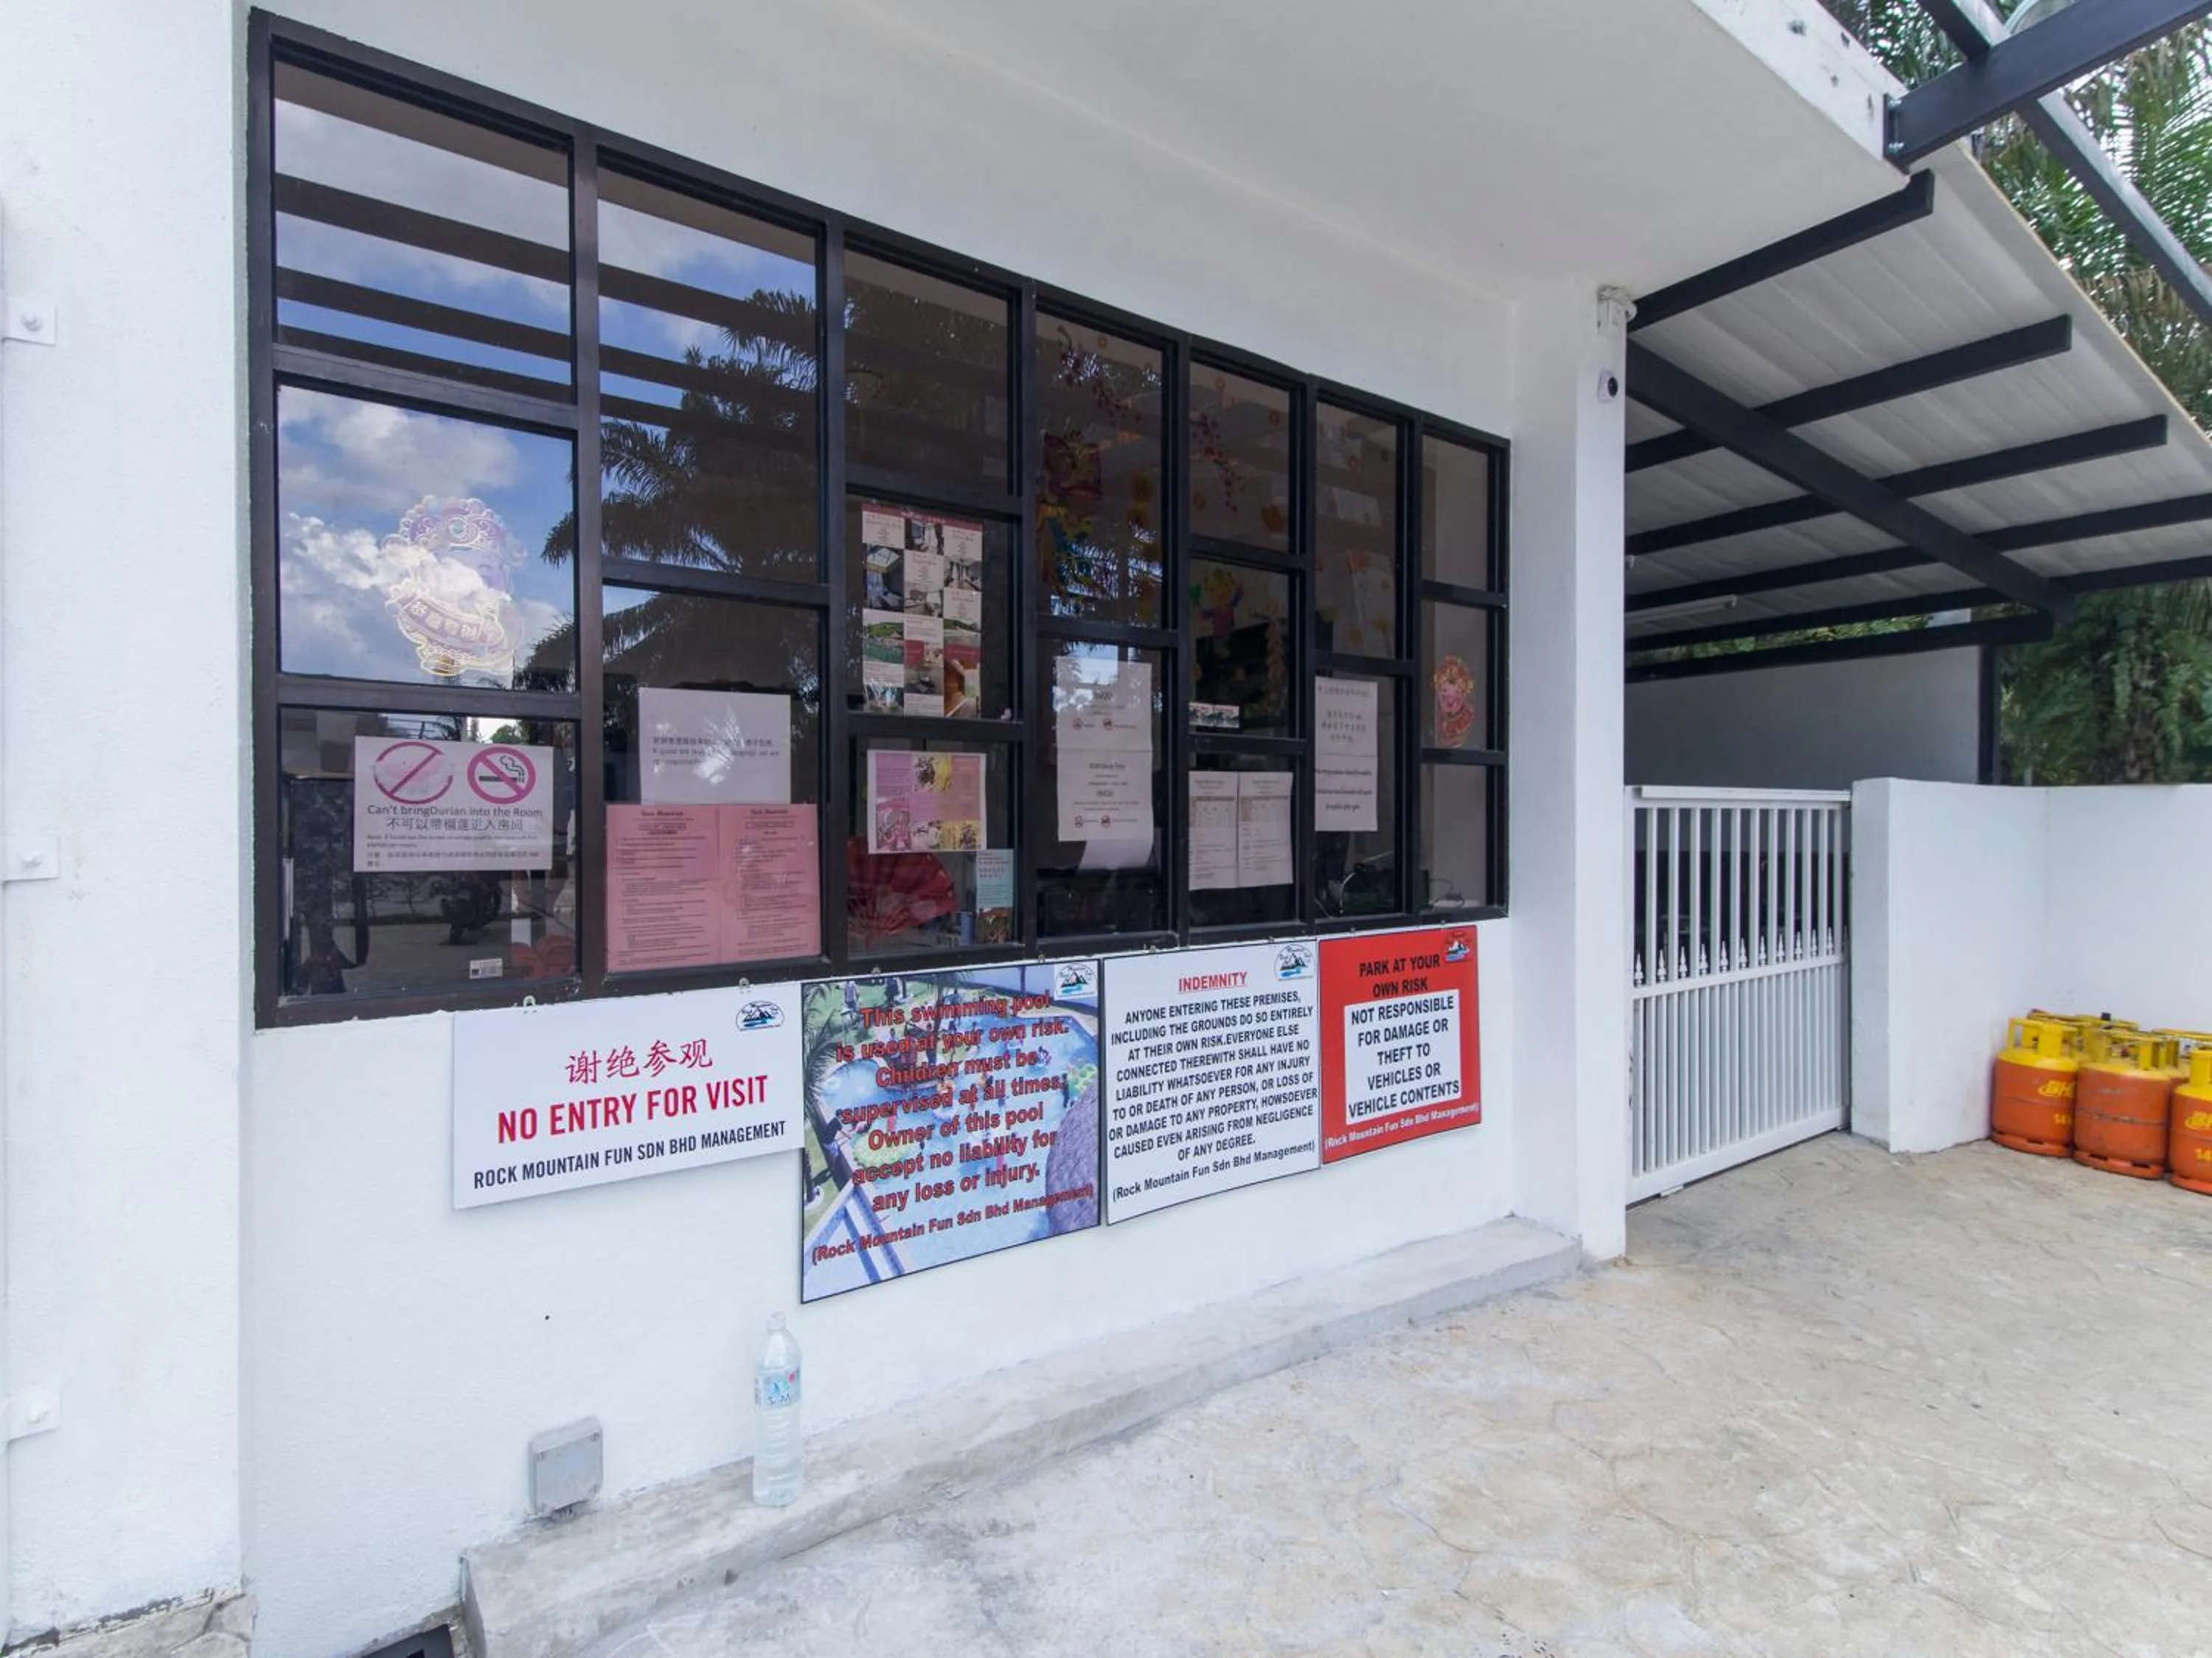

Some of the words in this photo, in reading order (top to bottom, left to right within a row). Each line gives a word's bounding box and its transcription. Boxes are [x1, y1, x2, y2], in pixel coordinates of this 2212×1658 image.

[470, 808, 490, 816] into
[493, 808, 509, 816] the
[513, 809, 543, 817] Room
[1179, 971, 1246, 992] INDEMNITY
[1359, 960, 1388, 977] PARK
[1393, 959, 1408, 971] AT
[1409, 954, 1440, 970] YOUR
[1125, 1007, 1166, 1024] ANYONE
[1169, 1000, 1217, 1017] ENTERING
[1221, 997, 1251, 1010] THESE
[1253, 991, 1301, 1007] PREMISES,
[1373, 982, 1399, 998] OWN
[1402, 979, 1428, 993] RISK
[860, 1005, 905, 1027] This
[911, 996, 1006, 1022] swimming
[1012, 990, 1051, 1016] pool
[1111, 1026, 1166, 1045] INCLUDING
[1169, 1022, 1188, 1036] THE
[1191, 1016, 1237, 1031] GROUNDS
[1239, 1013, 1253, 1024] DO
[1256, 1011, 1268, 1023] SO
[1270, 1006, 1312, 1021] ENTIRELY
[1352, 1008, 1374, 1025] NOT
[1378, 996, 1454, 1020] RESPONSIBLE
[837, 1044, 853, 1063] is
[861, 1036, 910, 1058] used
[915, 1034, 936, 1051] at
[942, 1027, 981, 1053] your
[988, 1021, 1026, 1041] own
[1032, 1019, 1069, 1038] risk.
[1127, 1048, 1141, 1061] AT
[1144, 1041, 1173, 1058] THEIR
[1175, 1038, 1198, 1052] OWN
[1277, 1024, 1299, 1037] ELSE
[1357, 1029, 1381, 1047] FOR
[1384, 1021, 1430, 1043] DAMAGE
[1433, 1019, 1448, 1033] OR
[565, 1038, 713, 1085] 谢绝参观
[876, 1061, 959, 1086] Children
[964, 1052, 1010, 1074] must
[1015, 1049, 1038, 1067] be
[1117, 1061, 1177, 1081] CONNECTED
[1180, 1051, 1235, 1069] THEREWITH
[1238, 1047, 1267, 1061] SHALL
[1270, 1042, 1294, 1055] HAVE
[1296, 1040, 1310, 1051] NO
[1377, 1047, 1413, 1066] THEFT
[1416, 1043, 1430, 1057] TO
[1116, 1082, 1164, 1101] LIABILITY
[1168, 1068, 1232, 1090] WHATSOEVER
[1235, 1065, 1253, 1079] FOR
[1256, 1061, 1275, 1074] ANY
[1277, 1056, 1310, 1070] INJURY
[1368, 1066, 1422, 1090] VEHICLES
[1425, 1062, 1440, 1078] OR
[497, 1107, 538, 1143] NO
[550, 1095, 635, 1135] ENTRY
[647, 1086, 698, 1120] FOR
[706, 1075, 768, 1110] VISIT
[841, 1085, 953, 1125] supervised
[959, 1085, 977, 1105] at
[984, 1080, 1006, 1099] all
[1011, 1075, 1062, 1096] times.
[1109, 1126, 1123, 1141] OR
[1127, 1117, 1168, 1137] DAMAGE
[1171, 1113, 1183, 1126] TO
[1185, 1109, 1205, 1123] ANY
[1208, 1098, 1258, 1117] PROPERTY,
[1261, 1088, 1318, 1107] HOWSOEVER
[1113, 1107, 1125, 1122] TO
[1129, 1103, 1143, 1117] OR
[1146, 1096, 1178, 1113] DEATH
[1181, 1092, 1194, 1106] OF
[1196, 1089, 1216, 1102] ANY
[1218, 1081, 1259, 1097] PERSON,
[1262, 1079, 1274, 1090] OR
[1276, 1075, 1299, 1087] LOSS
[1301, 1072, 1313, 1083] OF
[1349, 1093, 1397, 1118] VEHICLE
[1401, 1080, 1459, 1104] CONTENTS
[869, 1124, 934, 1151] Owner
[940, 1117, 960, 1137] of
[965, 1111, 1000, 1132] this
[1005, 1101, 1044, 1130] pool
[1114, 1139, 1153, 1159] CAUSED
[1157, 1131, 1182, 1148] EVEN
[1186, 1123, 1224, 1140] ARISING
[1228, 1117, 1253, 1132] FROM
[1256, 1105, 1313, 1125] NEGLIGENCE
[1325, 1134, 1346, 1149] (Rock
[1349, 1125, 1383, 1142] Mountain
[1384, 1122, 1398, 1131] Fun
[1400, 1117, 1413, 1128] Sdn
[1416, 1114, 1428, 1124] Bhd
[473, 1165, 518, 1189] ROCK
[522, 1152, 599, 1182] MOUNTAIN
[605, 1146, 633, 1167] FUN
[637, 1141, 664, 1160] SDN
[670, 1135, 697, 1155] BHD
[700, 1120, 786, 1149] MANAGEMENT
[852, 1155, 923, 1184] accept
[930, 1151, 953, 1169] no
[959, 1134, 1028, 1162] liability
[1032, 1128, 1058, 1148] for
[1178, 1147, 1190, 1160] OF
[1193, 1142, 1213, 1156] ANY
[1215, 1134, 1256, 1152] DEGREE.
[872, 1189, 908, 1213] any
[915, 1181, 954, 1202] loss
[960, 1176, 980, 1193] or
[985, 1162, 1040, 1187] injury.
[1113, 1182, 1141, 1201] (Rock
[1144, 1170, 1189, 1190] Mountain
[1192, 1165, 1211, 1179] Fun
[1213, 1160, 1231, 1173] Sdn
[1234, 1154, 1251, 1168] Bhd
[812, 1239, 855, 1266] (Rock
[859, 1224, 925, 1250] Mountain
[929, 1217, 953, 1233] Fun
[957, 1210, 981, 1226] Sdn
[985, 1202, 1009, 1219] Bhd
